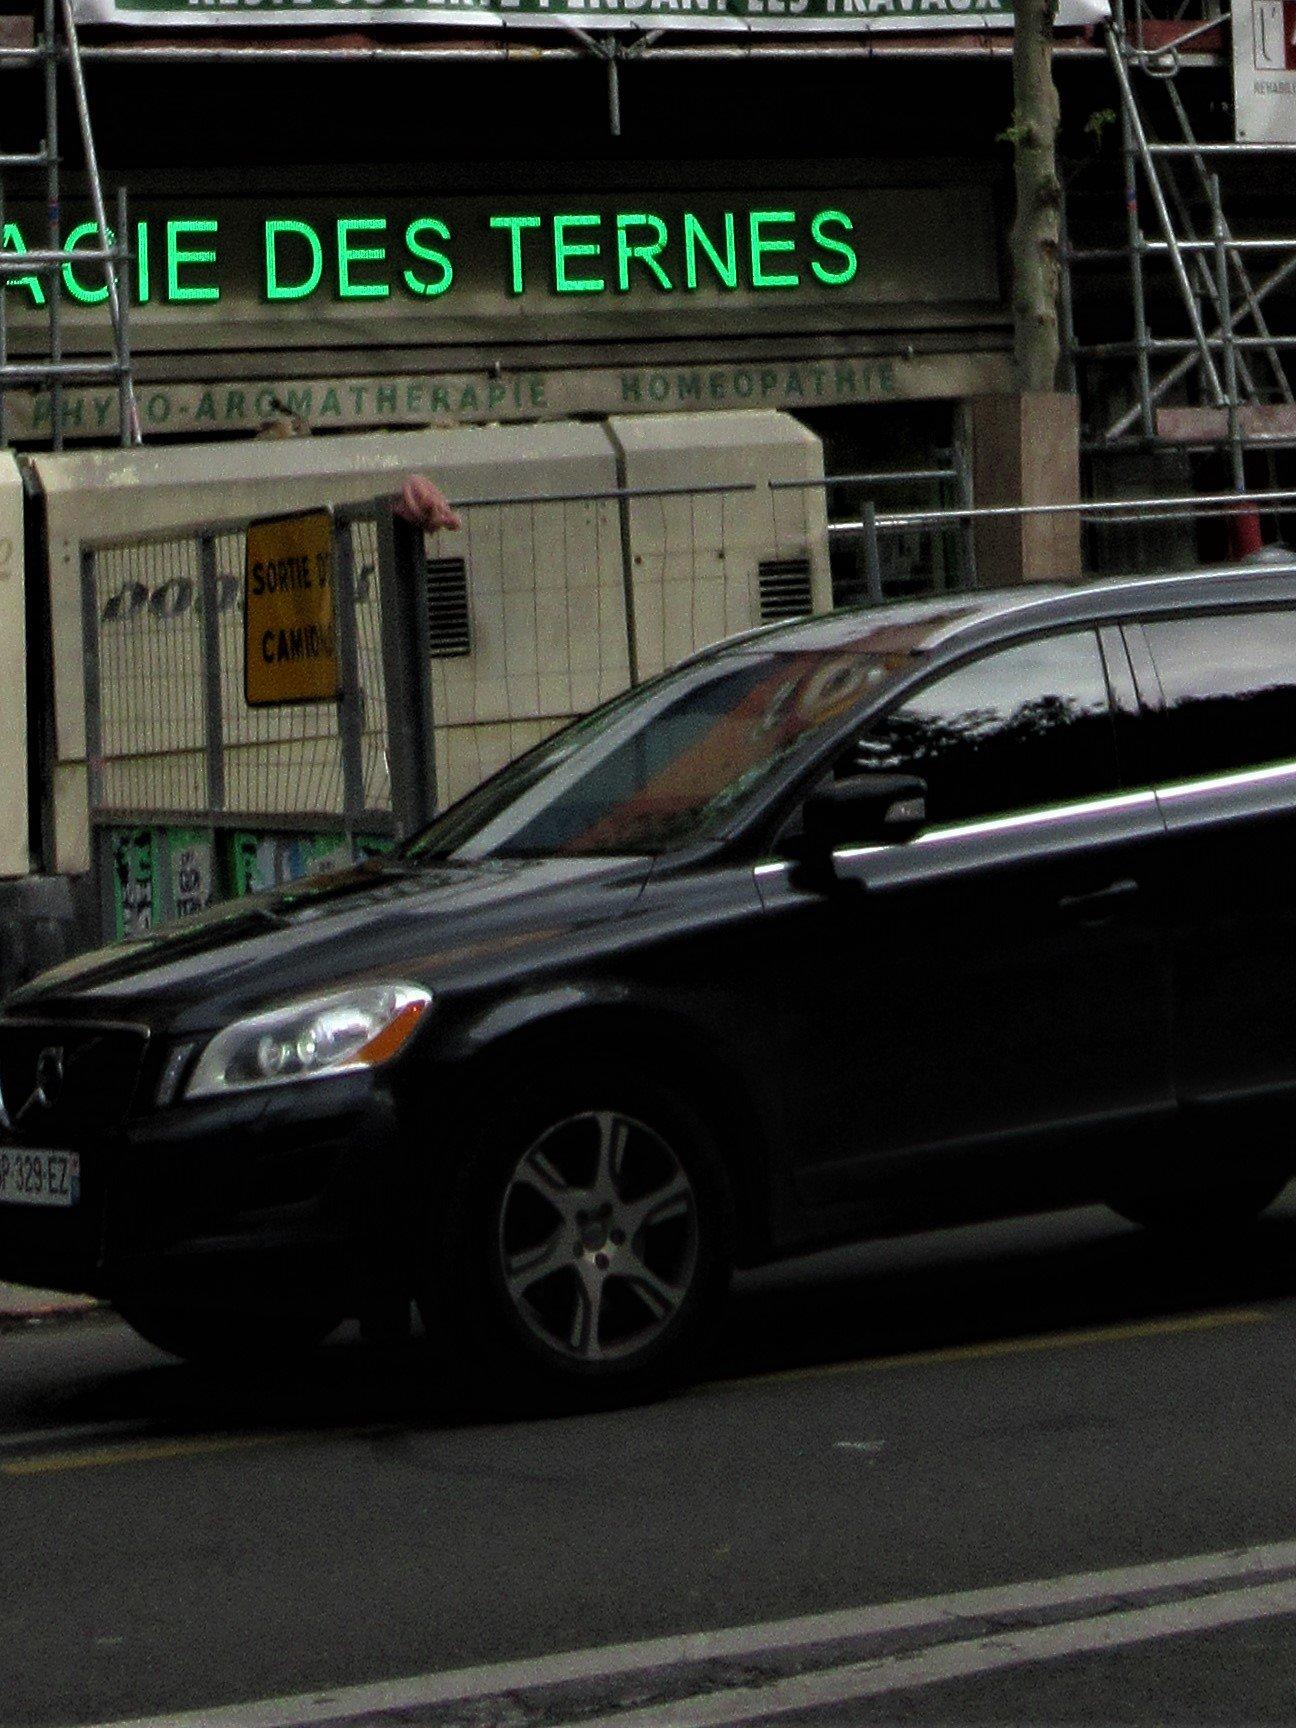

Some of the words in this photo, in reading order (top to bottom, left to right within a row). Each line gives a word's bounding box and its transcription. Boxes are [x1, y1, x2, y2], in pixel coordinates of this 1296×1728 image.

[265, 217, 453, 301] DES
[489, 208, 859, 295] TERNES
[31, 376, 547, 429] PHYO-AROMATHERAPIE
[253, 555, 310, 596] SORTIE
